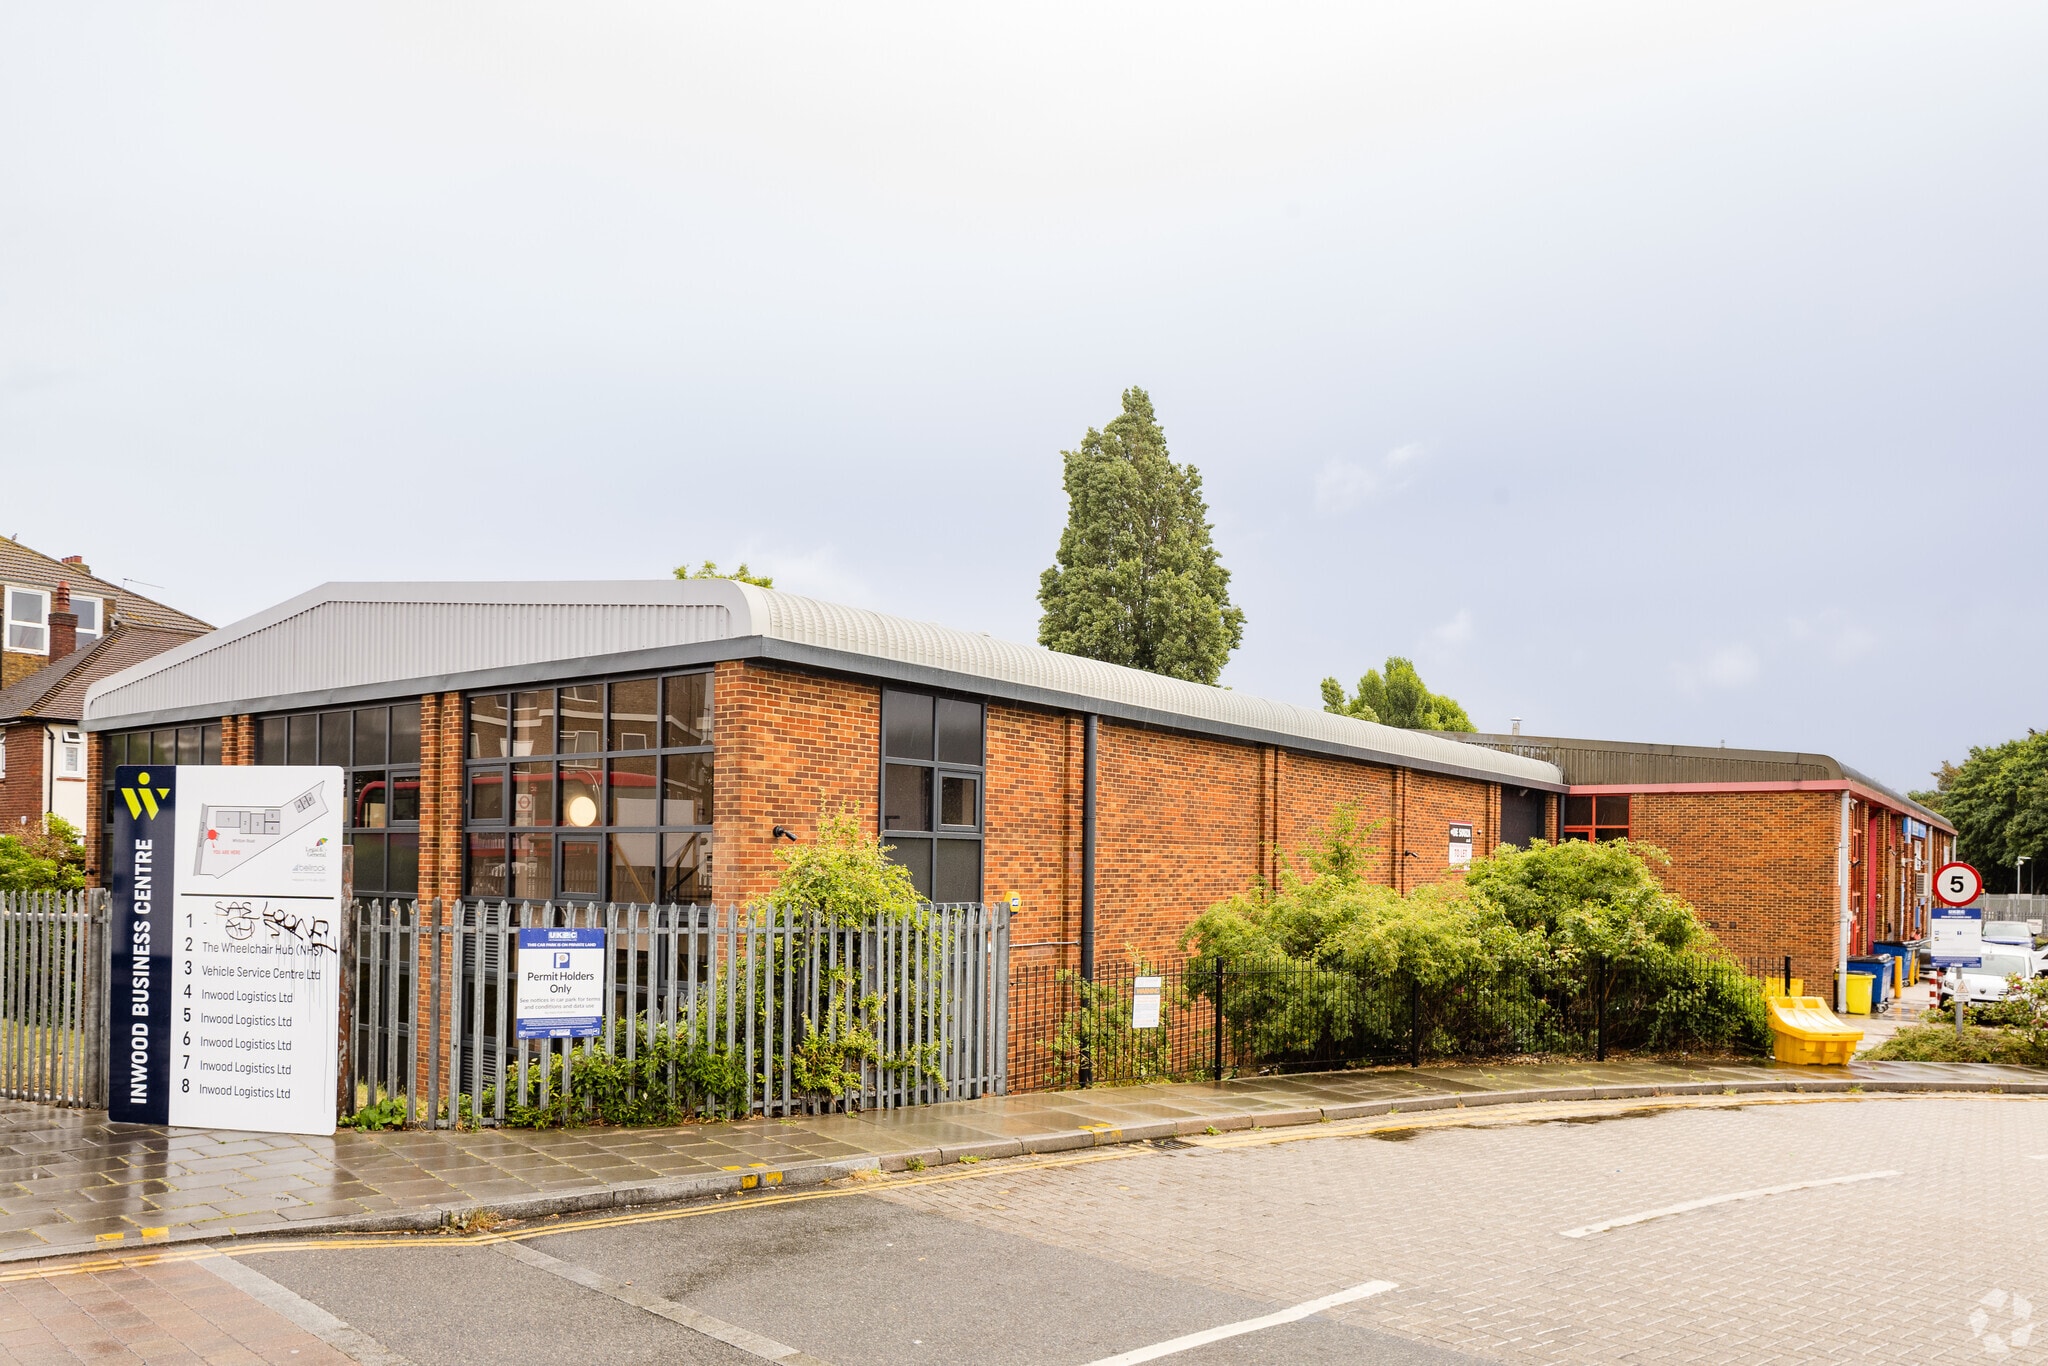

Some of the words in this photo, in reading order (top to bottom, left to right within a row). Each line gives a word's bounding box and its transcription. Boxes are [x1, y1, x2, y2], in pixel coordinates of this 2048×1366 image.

[134, 839, 153, 915] CENTRE
[1950, 876, 1964, 893] 5
[186, 913, 192, 928] 1
[185, 937, 193, 952] 2
[202, 941, 219, 953] The
[220, 942, 273, 955] Wheelchair
[275, 944, 294, 956] Hub
[132, 920, 151, 1016] BUSINESS
[184, 960, 192, 975] 3
[202, 965, 235, 977] Vehicle
[236, 967, 271, 979] Service
[273, 968, 305, 980] Centre
[306, 969, 321, 980] Ltd
[527, 971, 558, 981] Permit
[559, 971, 595, 981] Holders
[183, 984, 192, 999] 4
[201, 989, 235, 1001] Inwood
[237, 991, 277, 1004] Logistics
[278, 992, 294, 1003] Ltd
[549, 984, 572, 995] Only
[183, 1007, 191, 1023] 5
[200, 1013, 234, 1025] Inwood
[235, 1014, 276, 1027] Logistics
[277, 1016, 293, 1027] Ltd
[182, 1031, 191, 1046] 6
[200, 1036, 234, 1049] Inwood
[235, 1038, 276, 1051] Logistics
[277, 1040, 292, 1051] Ltd
[130, 1023, 149, 1104] INWOOD
[182, 1055, 190, 1070] 7
[200, 1060, 233, 1072] Inwood
[234, 1062, 275, 1075] Logistics
[277, 1064, 292, 1075] Ltd
[181, 1078, 190, 1094] 8
[199, 1084, 232, 1096] Inwood
[234, 1086, 275, 1099] Logistics
[276, 1088, 291, 1099] Ltd
